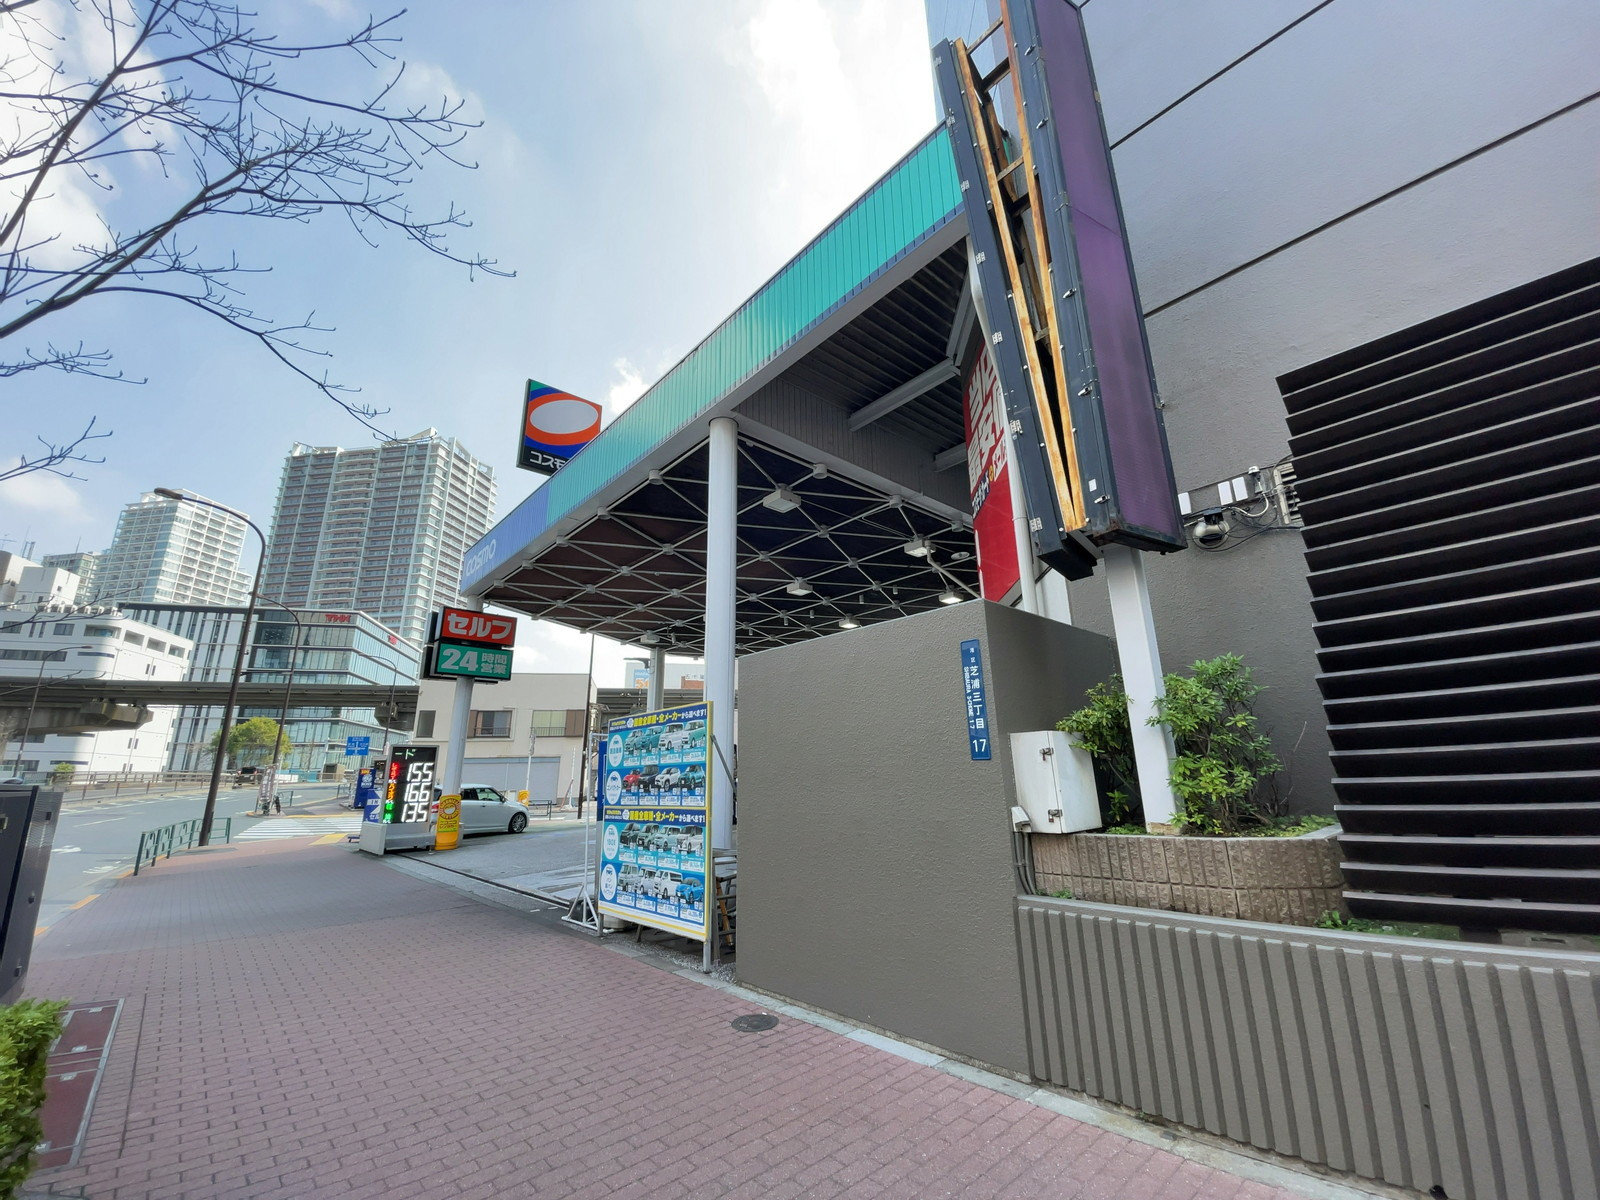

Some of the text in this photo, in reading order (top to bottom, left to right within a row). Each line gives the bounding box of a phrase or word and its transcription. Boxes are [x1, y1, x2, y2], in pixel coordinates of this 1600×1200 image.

[530, 450, 567, 471] コスモ
[466, 539, 497, 577] COSMO
[448, 613, 512, 639] セルフ
[441, 648, 478, 671] 24
[481, 653, 507, 664] 時間
[481, 663, 506, 674] 営業
[969, 665, 985, 729] 芝浦三丁目
[972, 739, 987, 752] 17
[406, 762, 434, 782] 155
[404, 782, 431, 802] 166
[401, 802, 429, 822] 135
